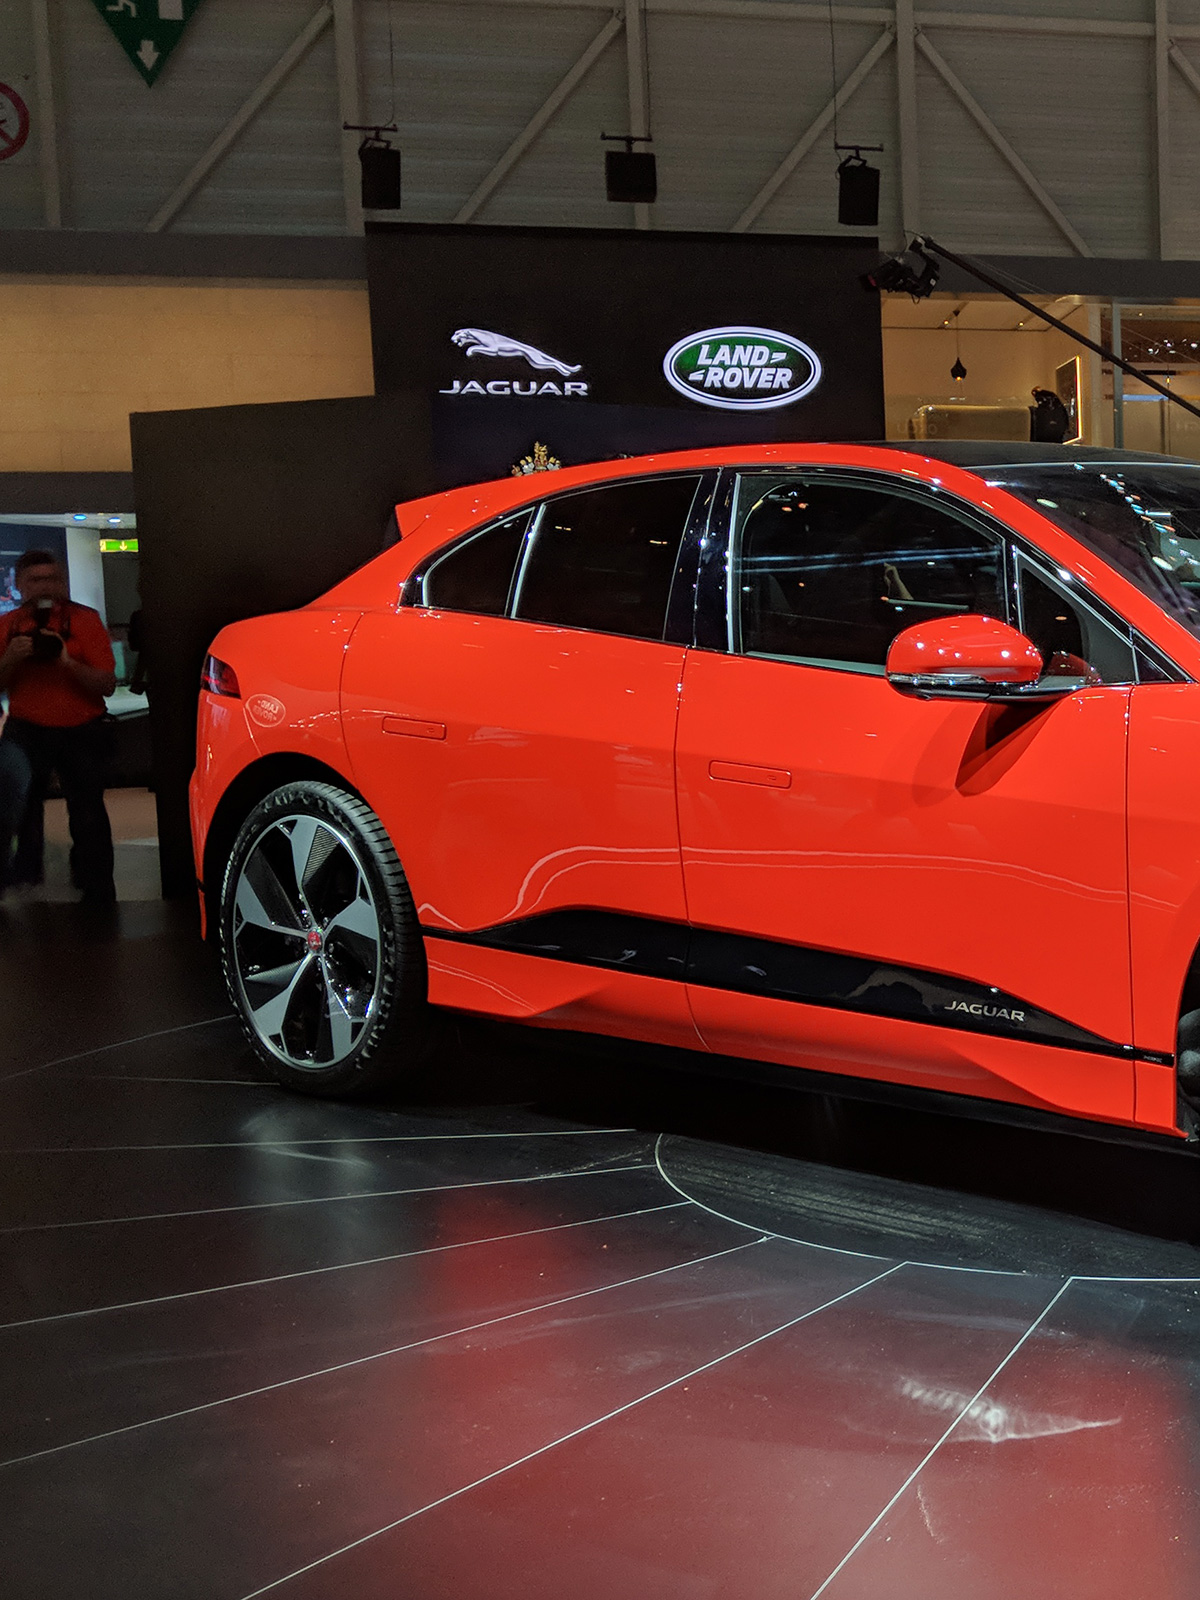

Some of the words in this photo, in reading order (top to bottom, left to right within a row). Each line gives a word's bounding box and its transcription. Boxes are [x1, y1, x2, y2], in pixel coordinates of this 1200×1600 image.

[697, 344, 771, 366] LAND
[439, 380, 589, 397] JAGUAR
[703, 367, 793, 390] ROVER
[944, 1000, 1025, 1021] JAGUAR
